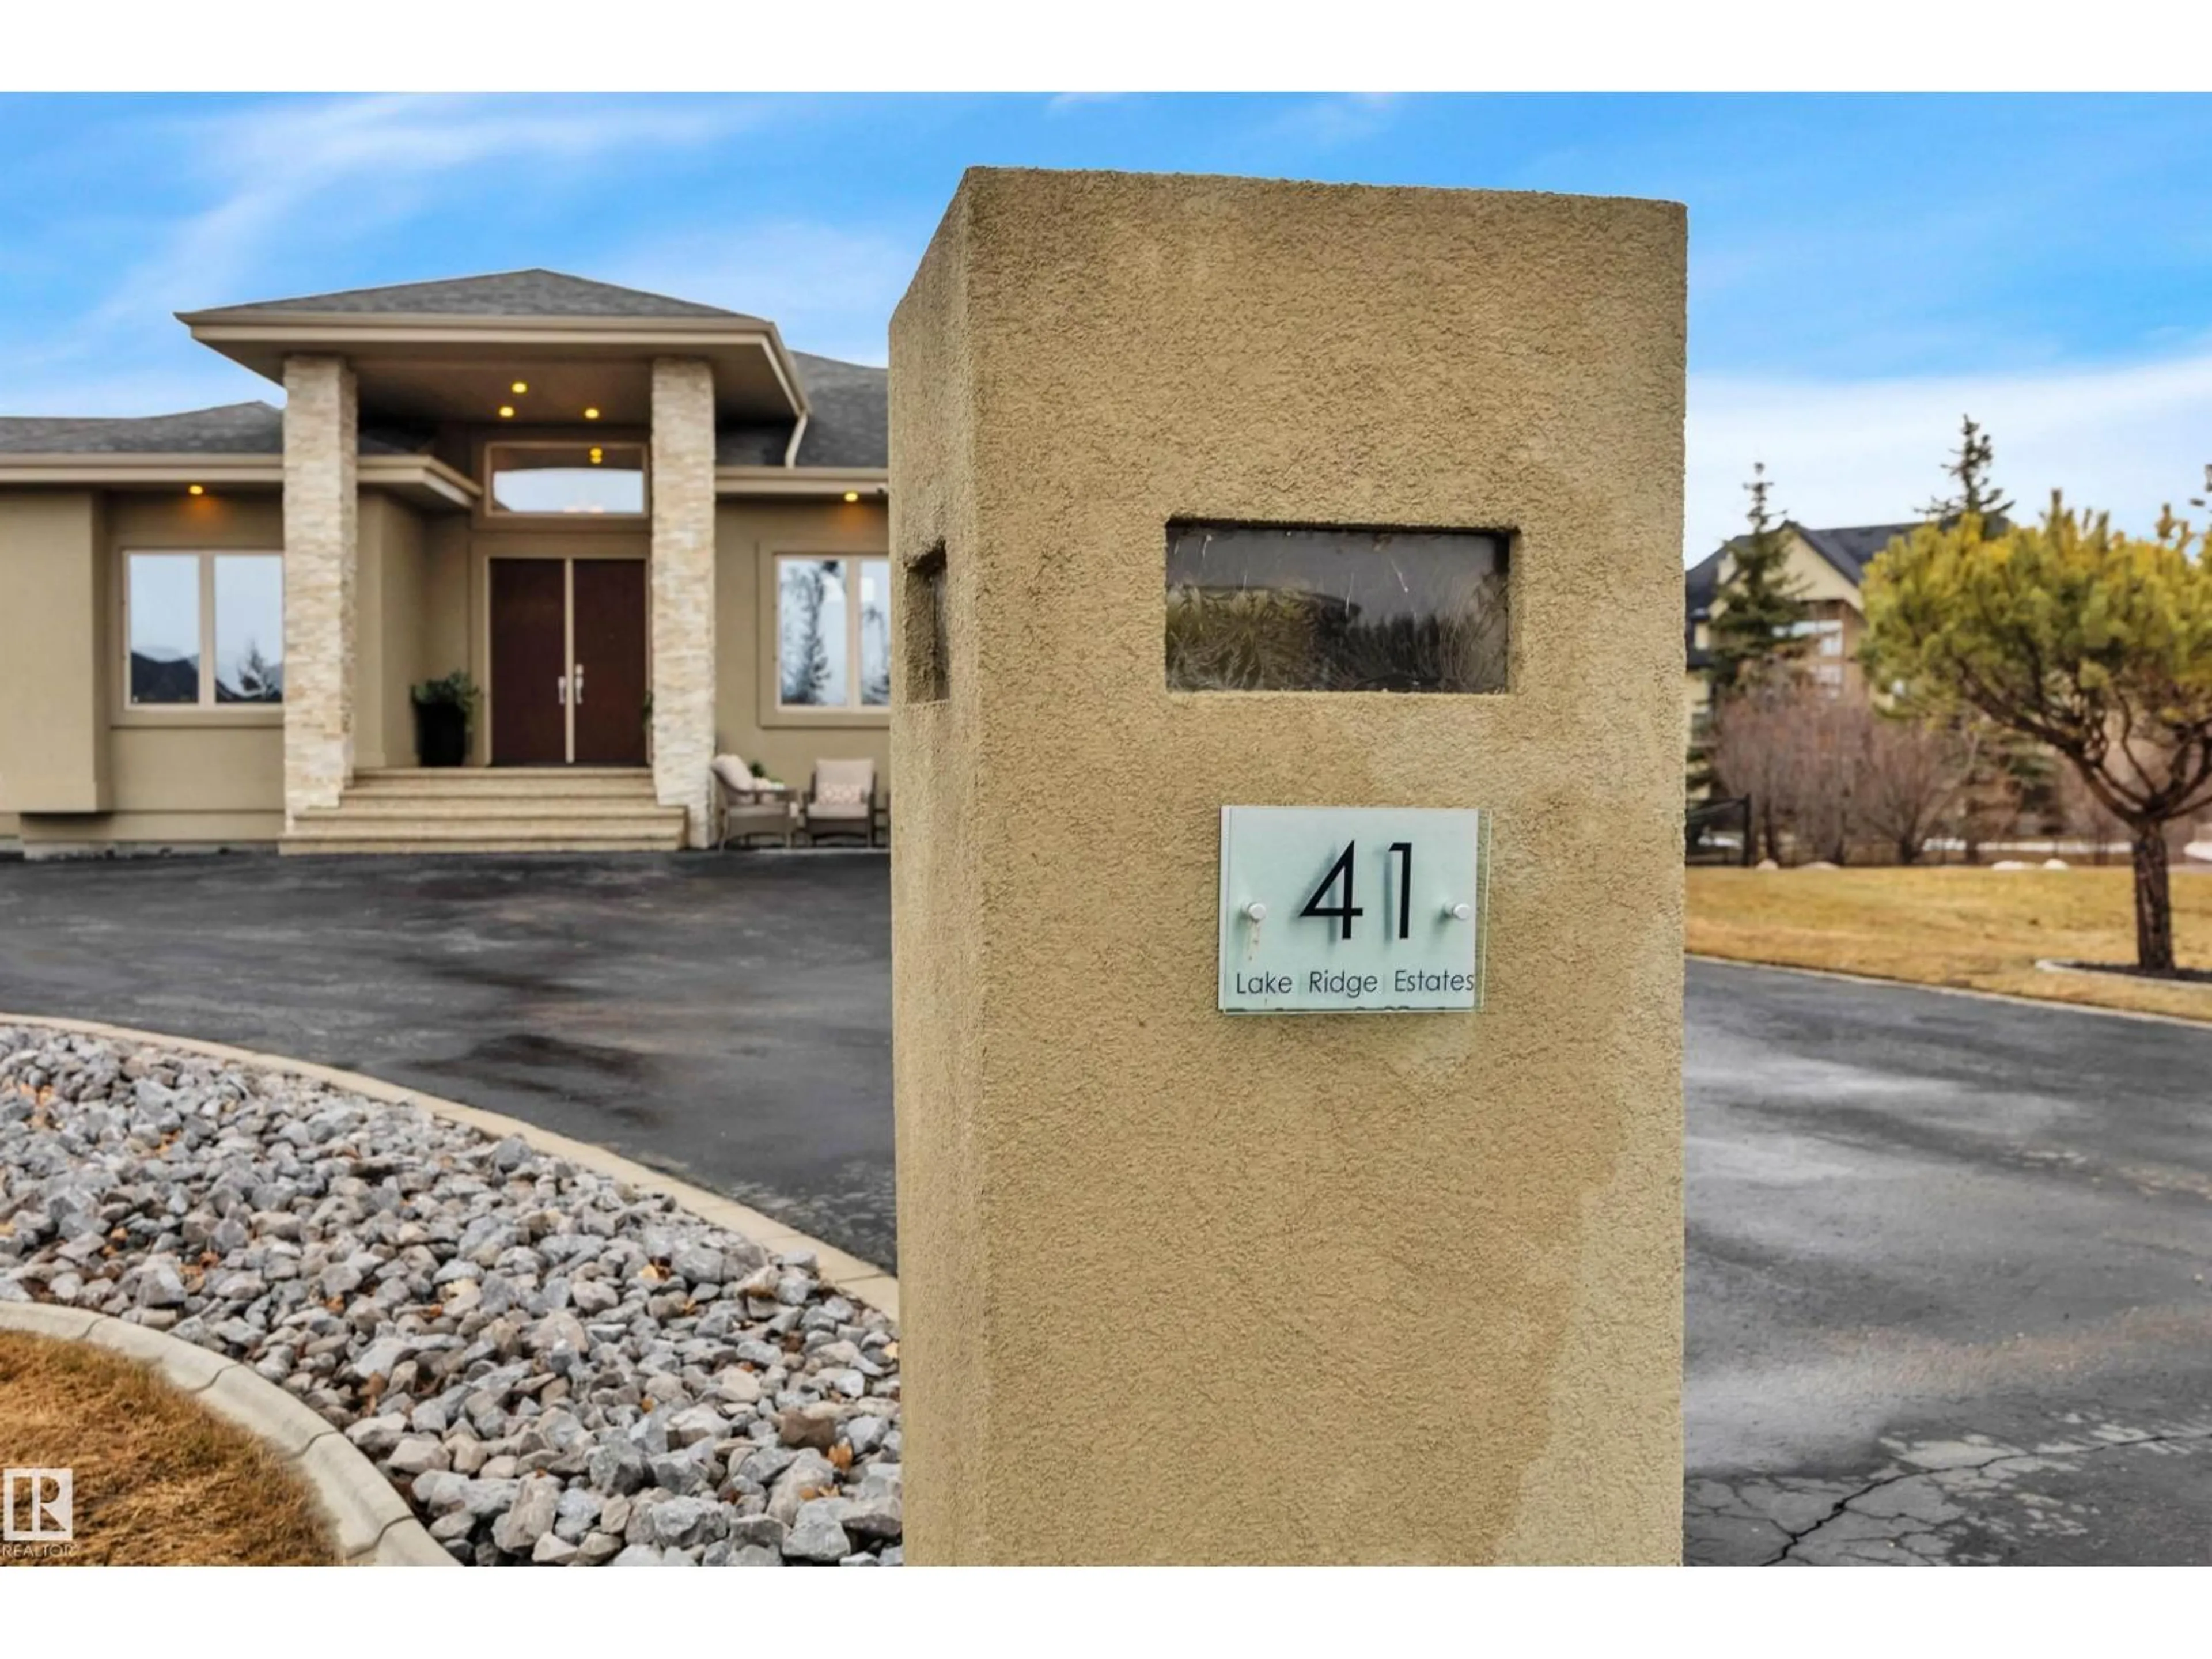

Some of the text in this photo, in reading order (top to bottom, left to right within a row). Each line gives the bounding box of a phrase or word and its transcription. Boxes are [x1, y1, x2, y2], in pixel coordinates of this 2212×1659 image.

[1299, 840, 1412, 939] 41
[1236, 969, 1475, 998] Lake Ridge Estates
